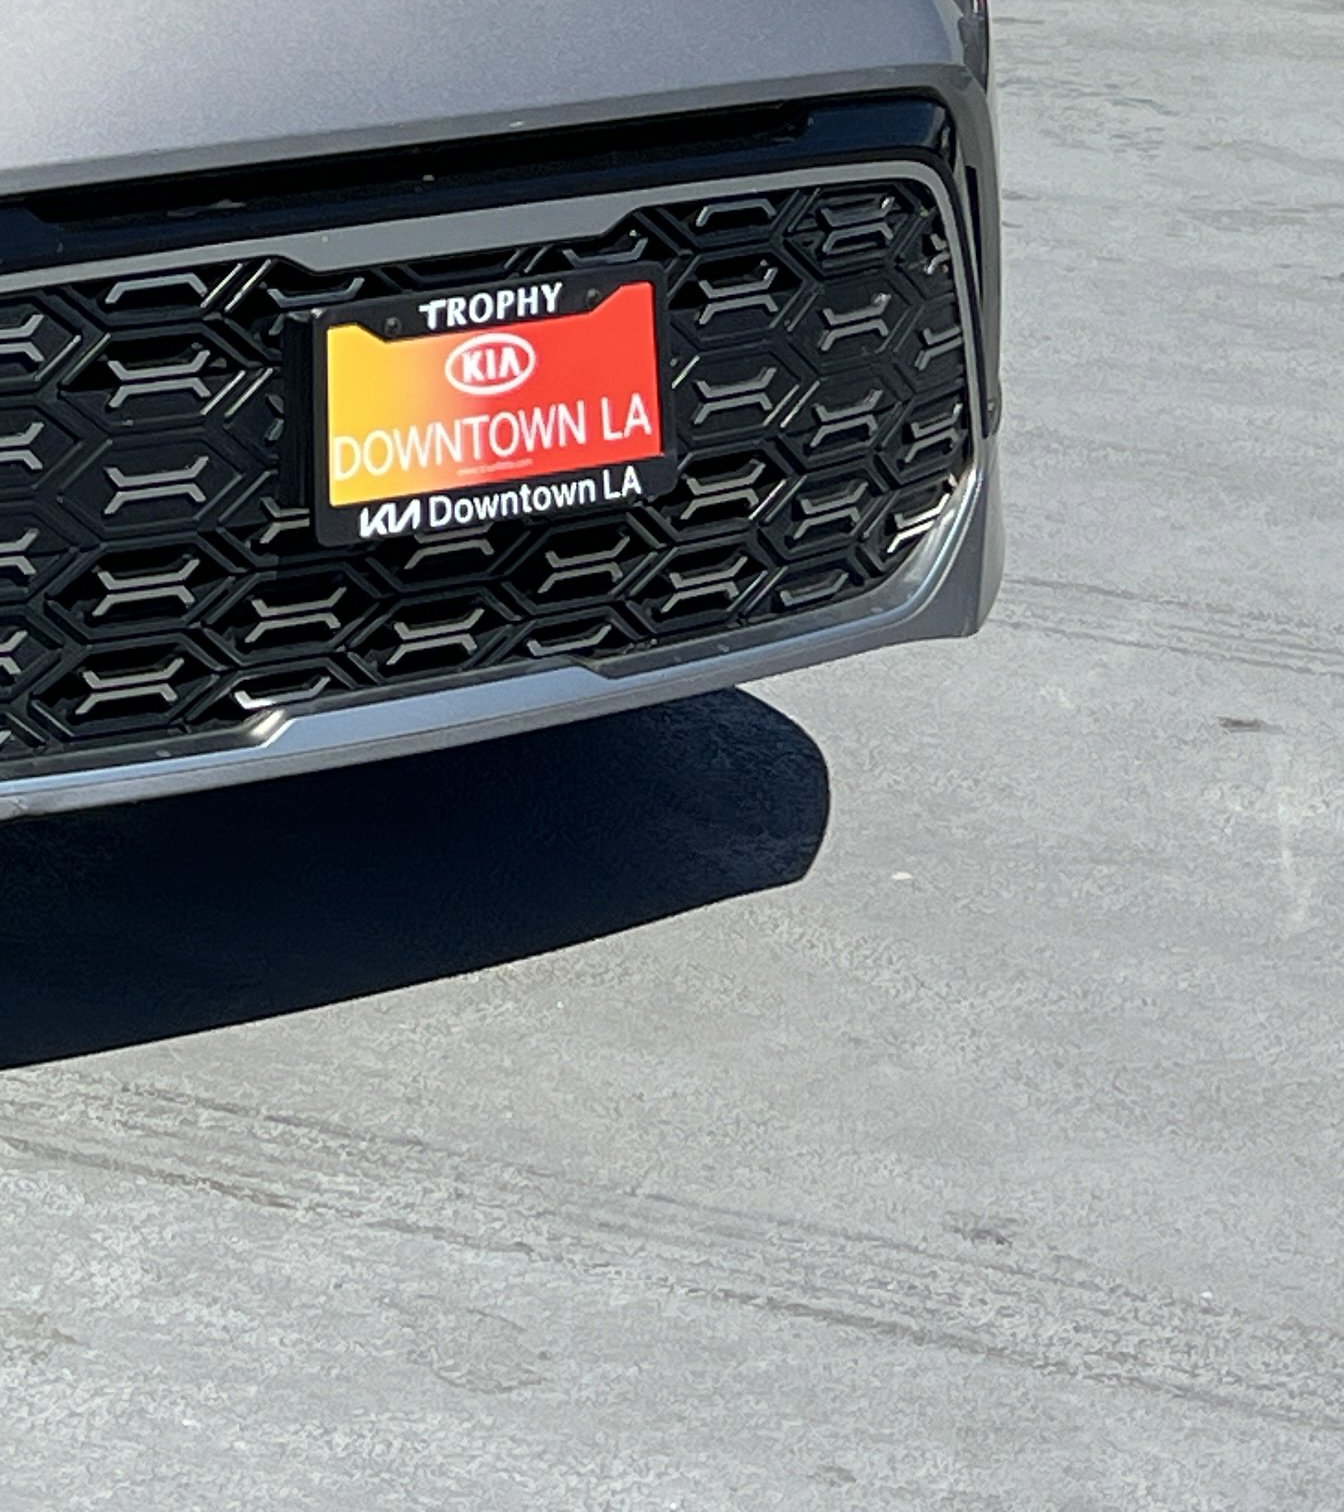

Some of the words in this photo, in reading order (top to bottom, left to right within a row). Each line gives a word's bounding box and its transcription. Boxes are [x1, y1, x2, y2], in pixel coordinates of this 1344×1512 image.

[418, 281, 564, 330] TROPHY
[460, 347, 522, 384] KIA
[332, 400, 586, 482] DOWNTOWN
[601, 392, 653, 442] LA
[359, 501, 421, 539] KIA
[428, 471, 597, 529] Downtown
[603, 464, 643, 501] LA
